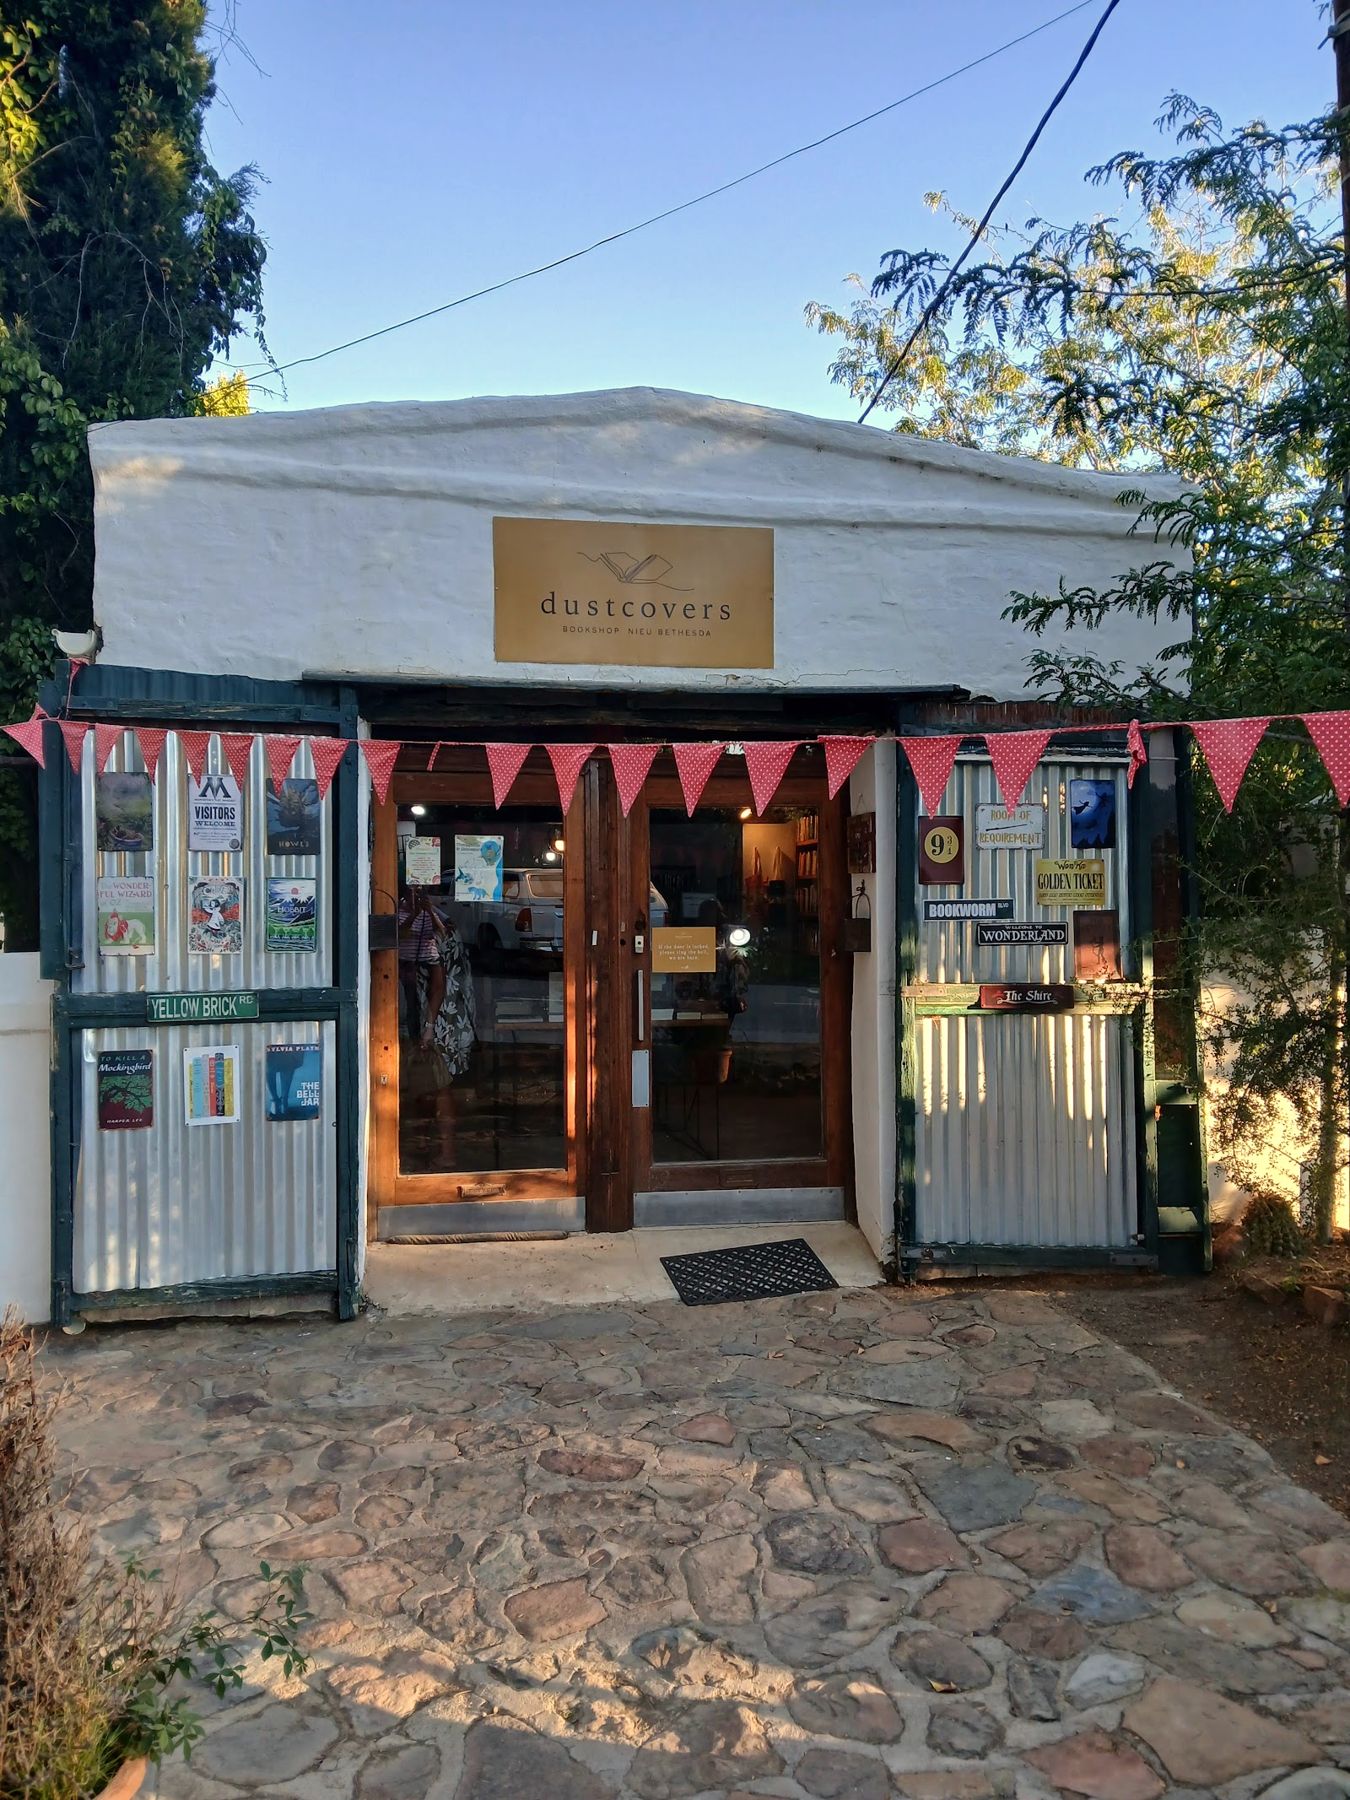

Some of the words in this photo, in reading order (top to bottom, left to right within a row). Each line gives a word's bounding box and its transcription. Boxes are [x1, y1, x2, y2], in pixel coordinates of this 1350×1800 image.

[540, 591, 731, 620] dustcovers
[562, 625, 620, 634] BOOKSHOP
[627, 627, 652, 635] NIEU
[657, 628, 711, 637] BETHESDA
[194, 806, 236, 820] VISITORS
[1019, 811, 1031, 820] OF
[979, 832, 1041, 844] REQUIREMENT
[930, 833, 945, 856] 9
[112, 882, 152, 890] WONDER-
[1037, 873, 1071, 890] GOLDEN
[1073, 873, 1104, 890] TICKET
[118, 890, 152, 898] WIZARD
[929, 903, 997, 918] BOOKWORM
[981, 929, 1065, 942] WONDERLAND
[1003, 990, 1023, 1001] The
[1025, 989, 1052, 1001] Shire
[152, 998, 200, 1019] YELLOW
[203, 996, 237, 1017] BRICK
[240, 995, 254, 1004] RD
[98, 1062, 152, 1075] Mockingbird
[301, 1082, 320, 1090] THE
[296, 1090, 320, 1099] BELL
[301, 1098, 320, 1106] JAR
